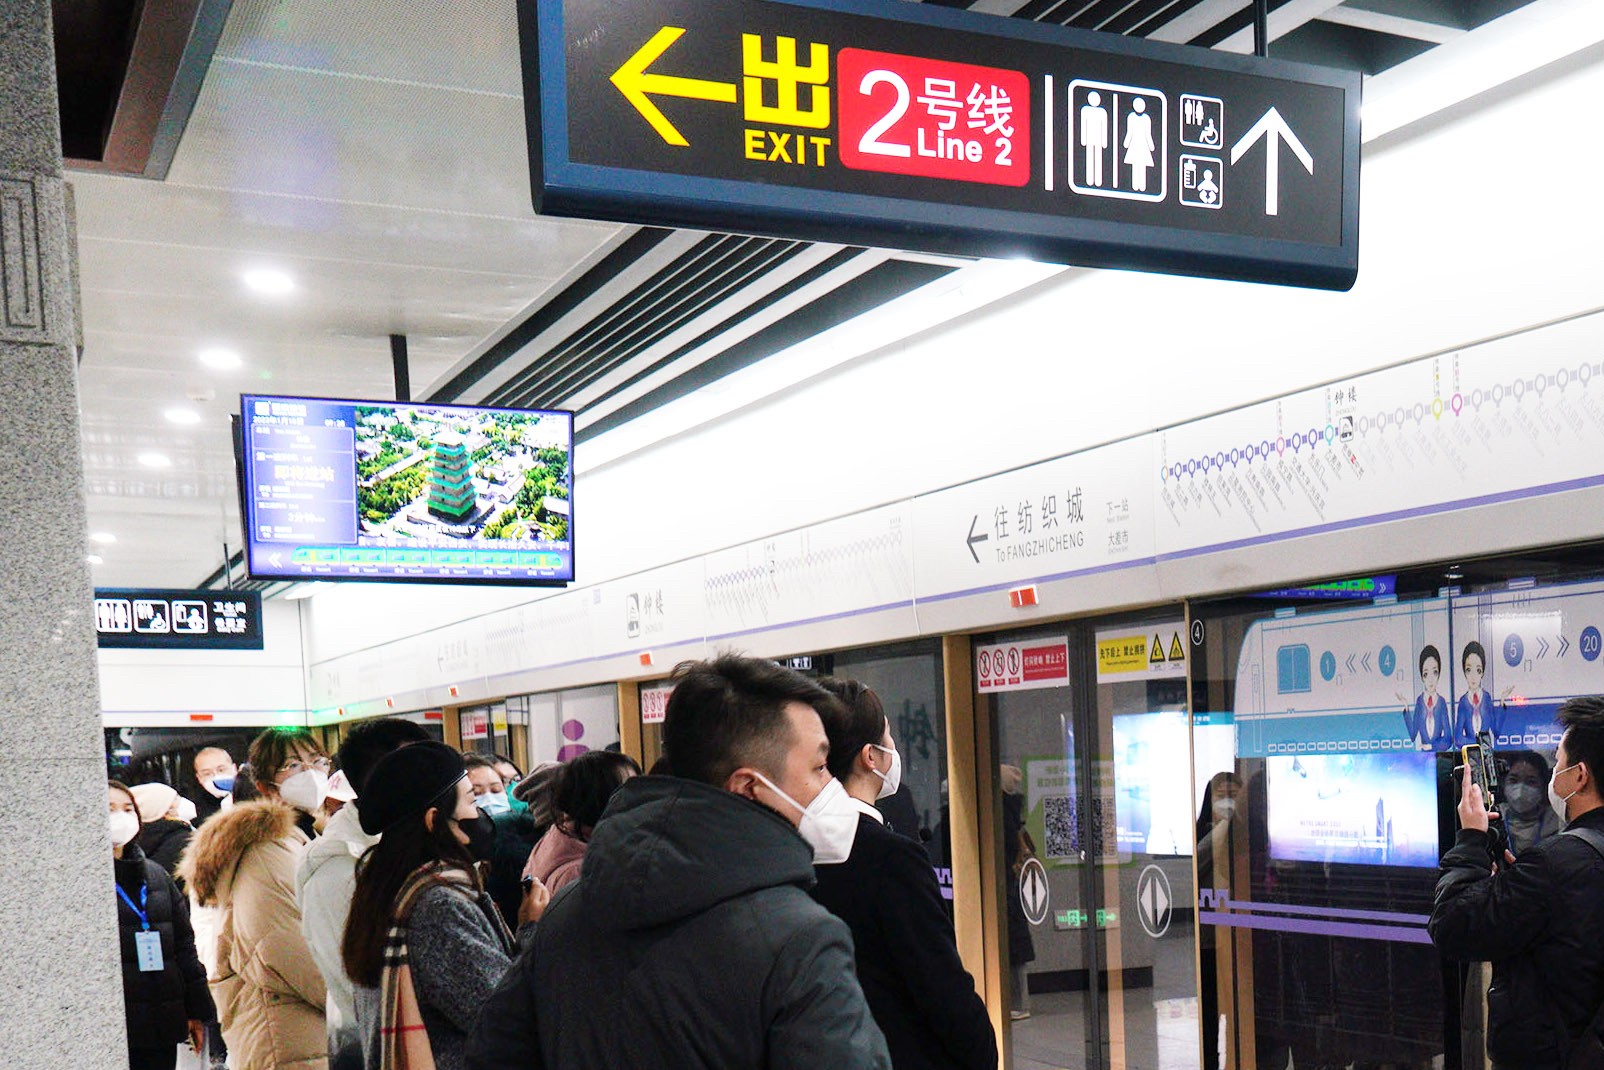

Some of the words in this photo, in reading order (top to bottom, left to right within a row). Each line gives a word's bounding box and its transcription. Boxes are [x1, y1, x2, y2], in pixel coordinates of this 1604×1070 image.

[742, 32, 830, 128] 出
[744, 129, 832, 168] EXIT
[917, 127, 984, 163] Line
[994, 136, 1013, 167] 2
[994, 486, 1084, 541] 往纺织城
[996, 547, 1006, 563] To
[1006, 531, 1085, 561] FANGZHICHENG
[1583, 634, 1599, 654] 20
